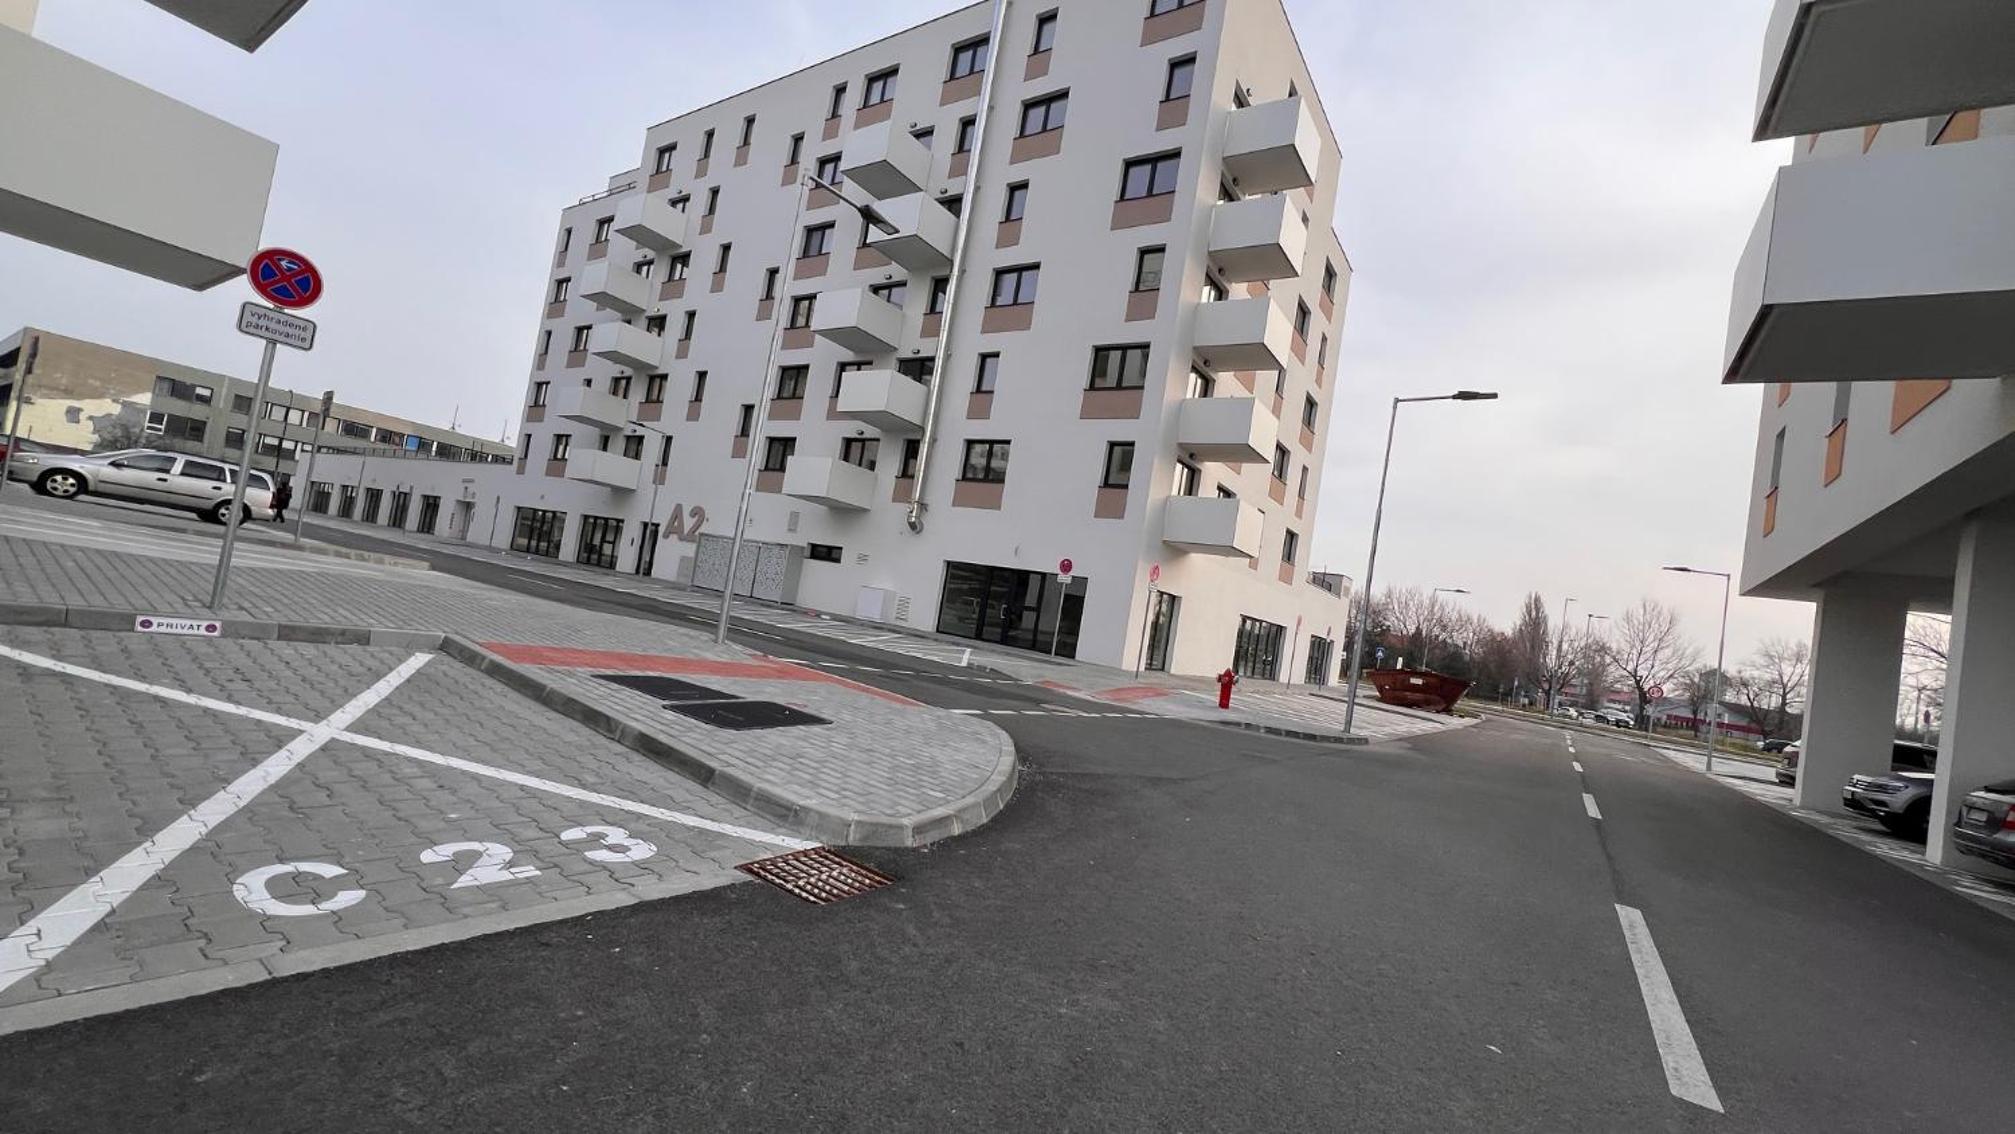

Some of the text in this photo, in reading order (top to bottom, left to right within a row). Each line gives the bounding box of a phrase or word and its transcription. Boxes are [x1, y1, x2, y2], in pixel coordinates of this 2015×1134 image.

[245, 321, 307, 343] parkovanie
[249, 310, 309, 332] vyhradené
[662, 503, 705, 543] A2
[156, 621, 202, 631] PRIVAT
